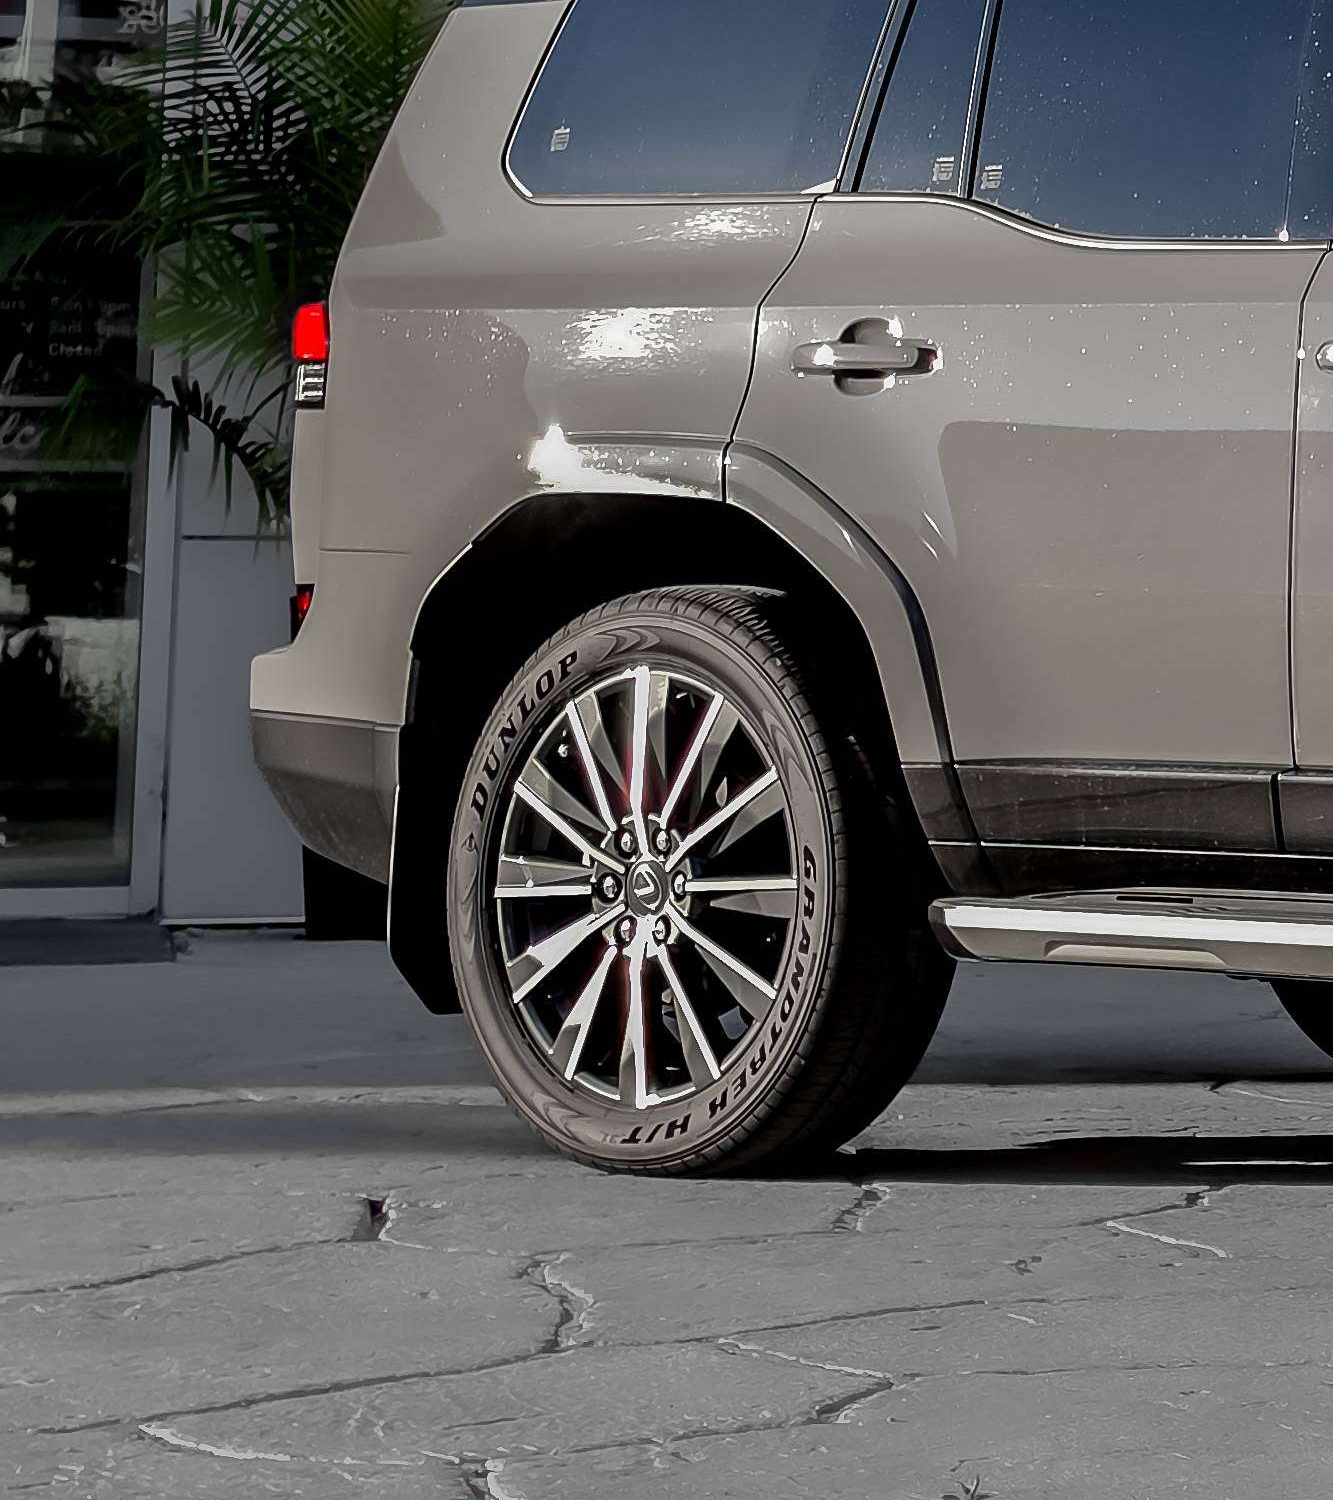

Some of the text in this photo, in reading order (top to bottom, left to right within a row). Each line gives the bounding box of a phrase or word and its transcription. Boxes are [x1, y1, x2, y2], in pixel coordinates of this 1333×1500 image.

[470, 650, 579, 823] DUNLOP
[708, 845, 817, 1119] GRANDTREK
[620, 1113, 692, 1144] H/T
